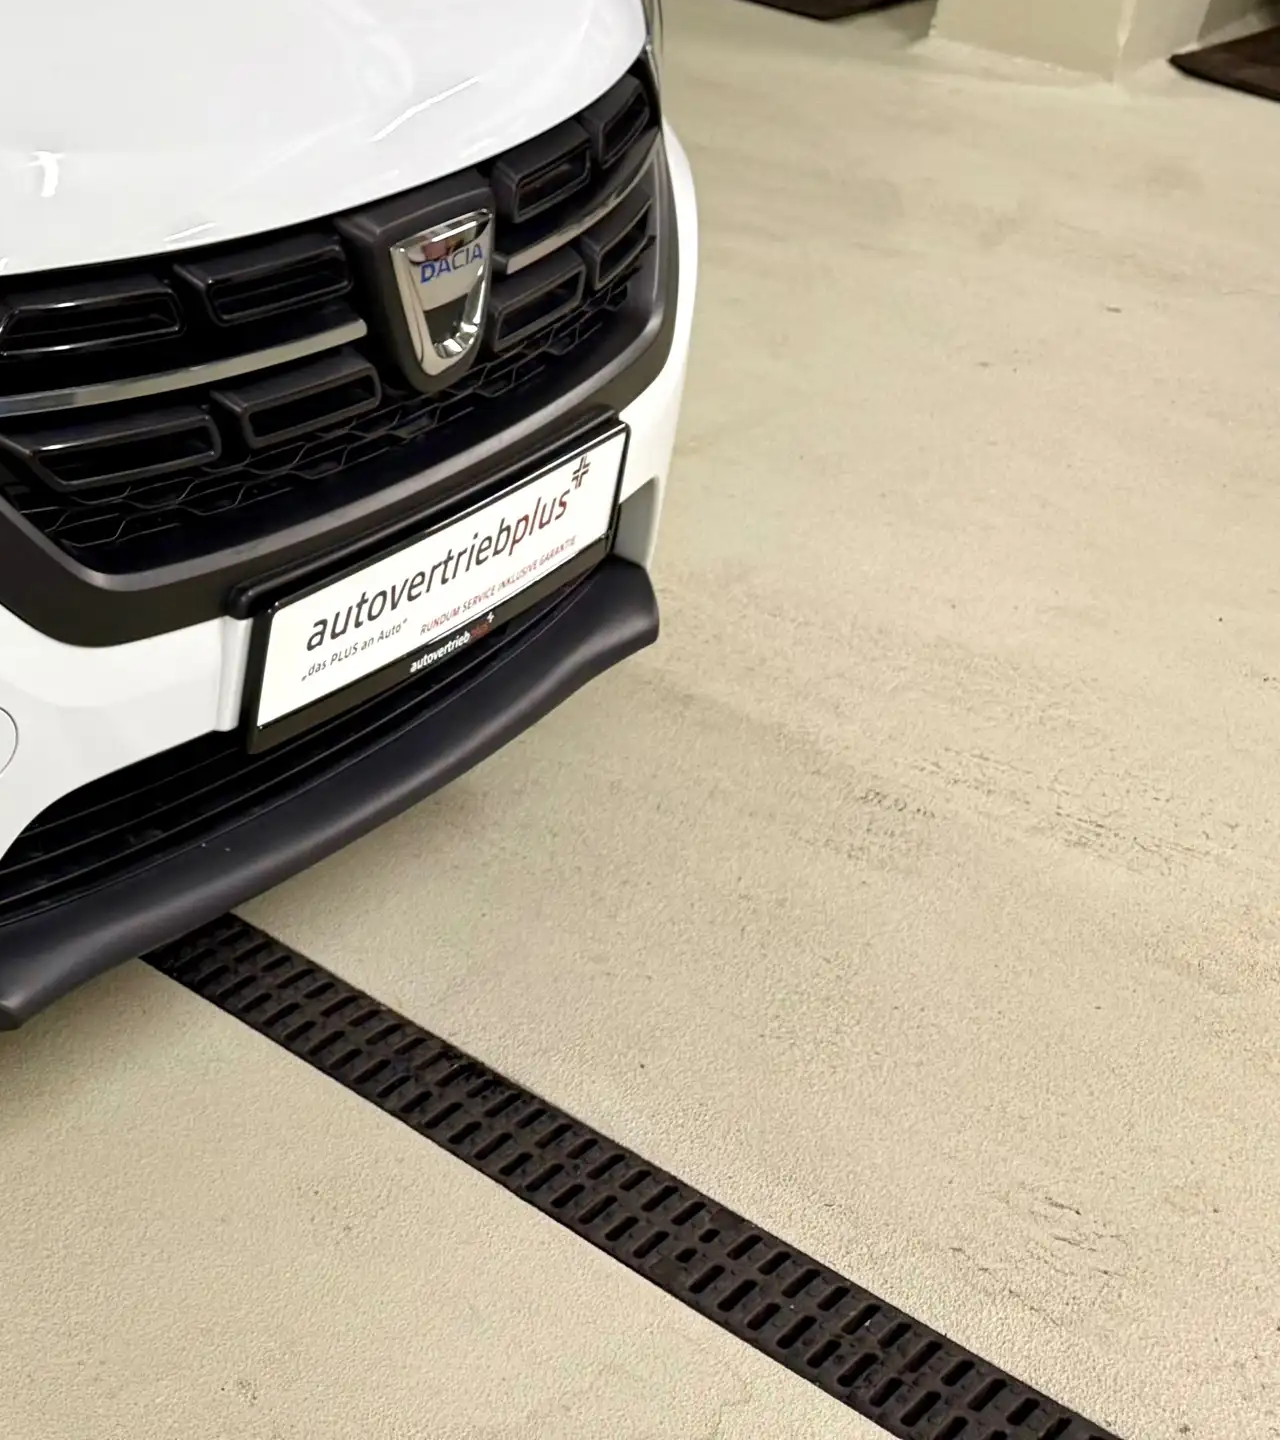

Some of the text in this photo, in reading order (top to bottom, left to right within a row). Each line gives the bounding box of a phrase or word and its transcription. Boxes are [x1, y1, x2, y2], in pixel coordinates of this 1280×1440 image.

[420, 243, 483, 284] DACIA
[420, 606, 460, 635] RUNDUM
[462, 584, 495, 613] SERVICE
[497, 561, 537, 592] INKLUSIVE
[330, 642, 359, 665] PLUS
[361, 637, 375, 651] an
